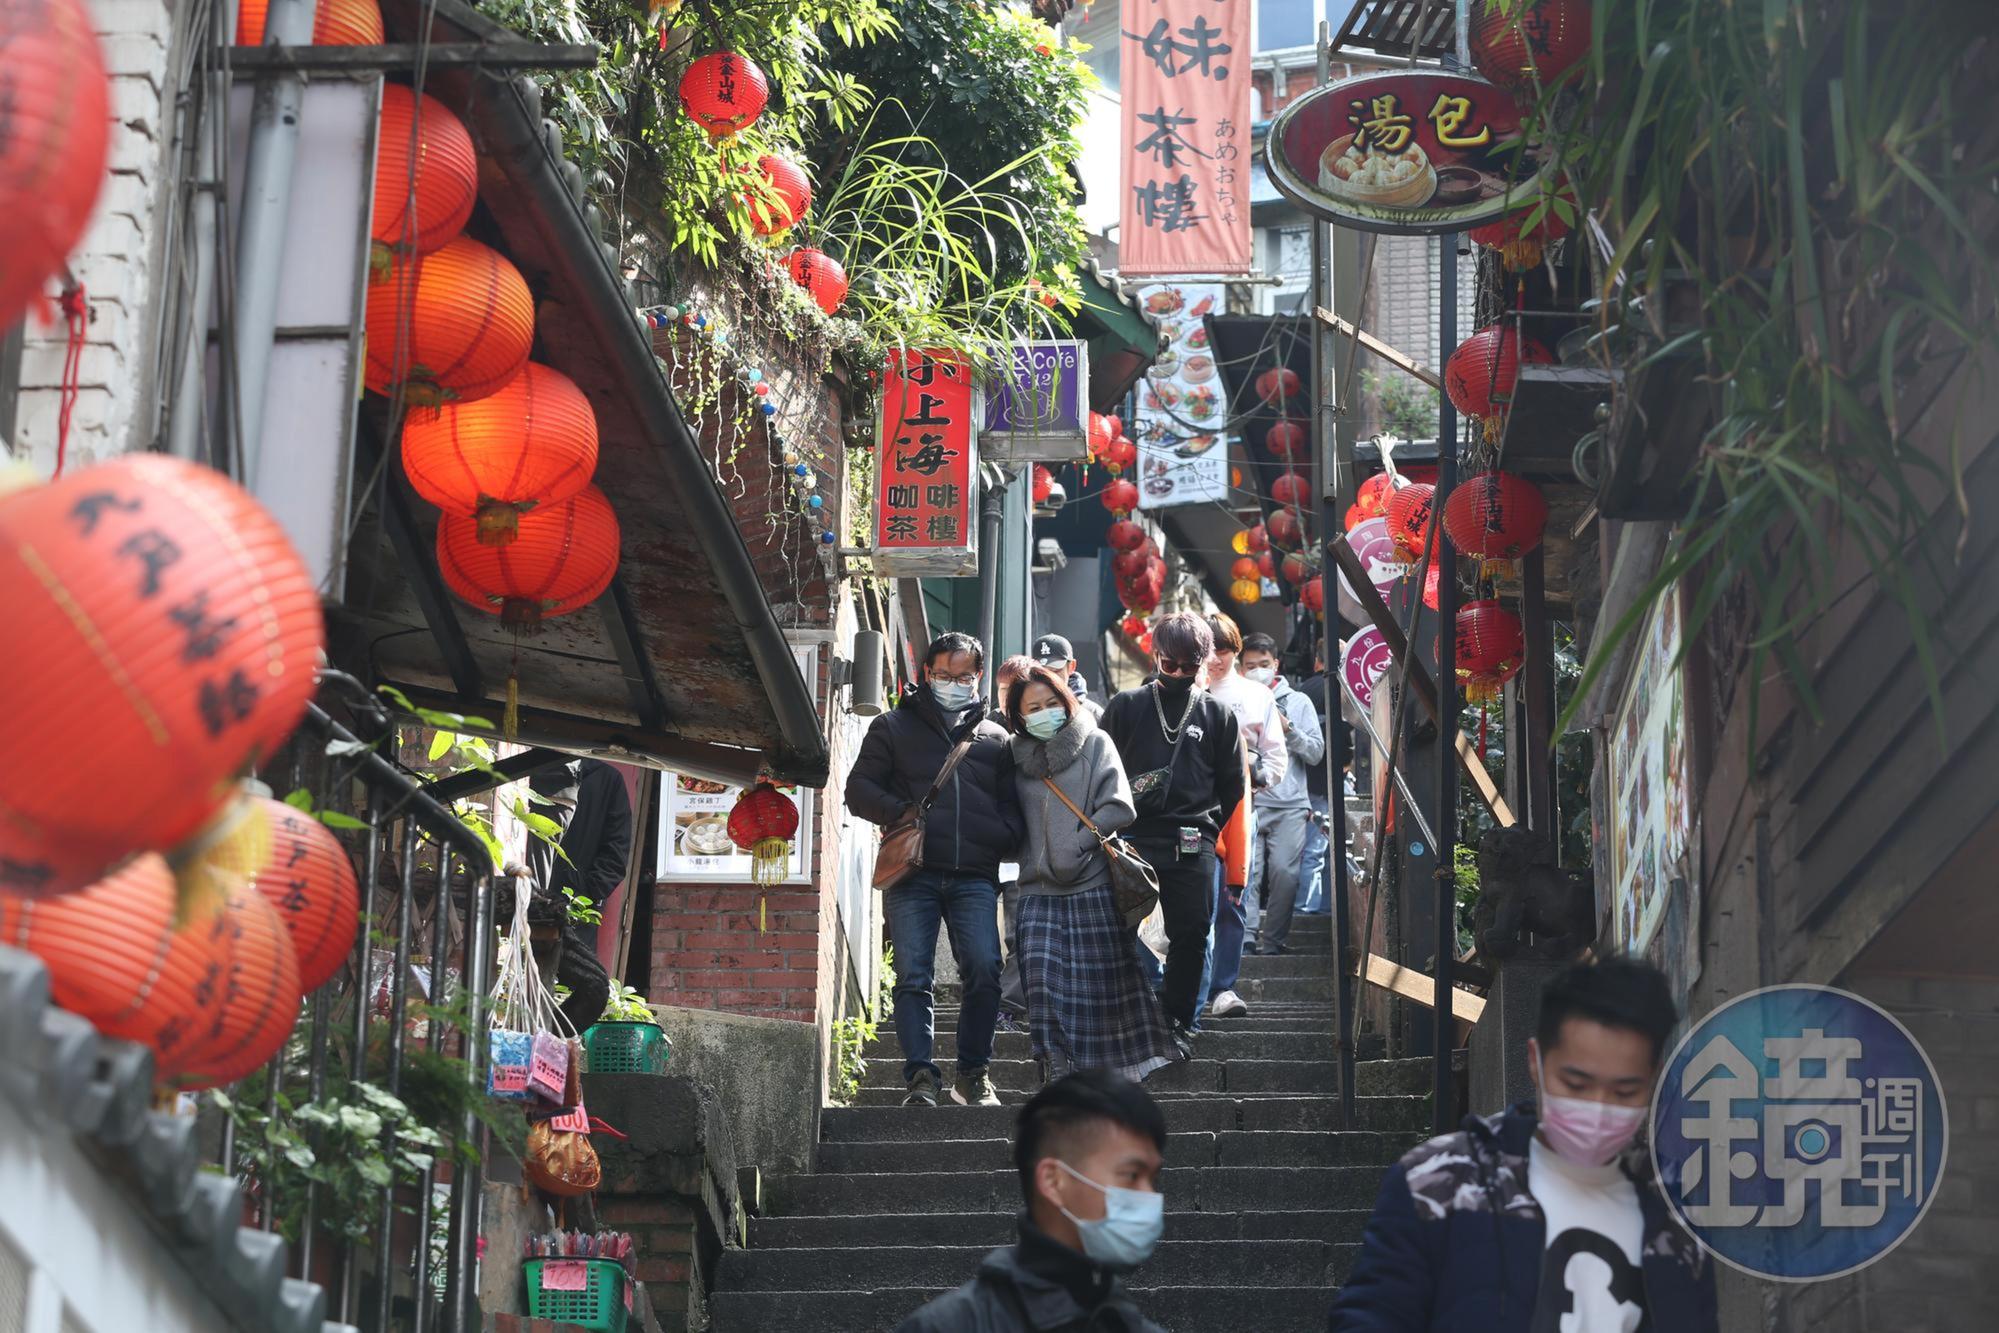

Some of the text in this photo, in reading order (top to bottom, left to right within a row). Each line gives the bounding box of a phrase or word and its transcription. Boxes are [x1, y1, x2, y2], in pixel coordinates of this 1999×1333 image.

[1122, 0, 1231, 232] 妹茶樓
[1348, 94, 1491, 151] 湯包
[1214, 118, 1237, 226] あめおちゃ
[895, 353, 958, 476] 小上海
[886, 515, 960, 541] 茶樓
[887, 484, 960, 509] 咖啡
